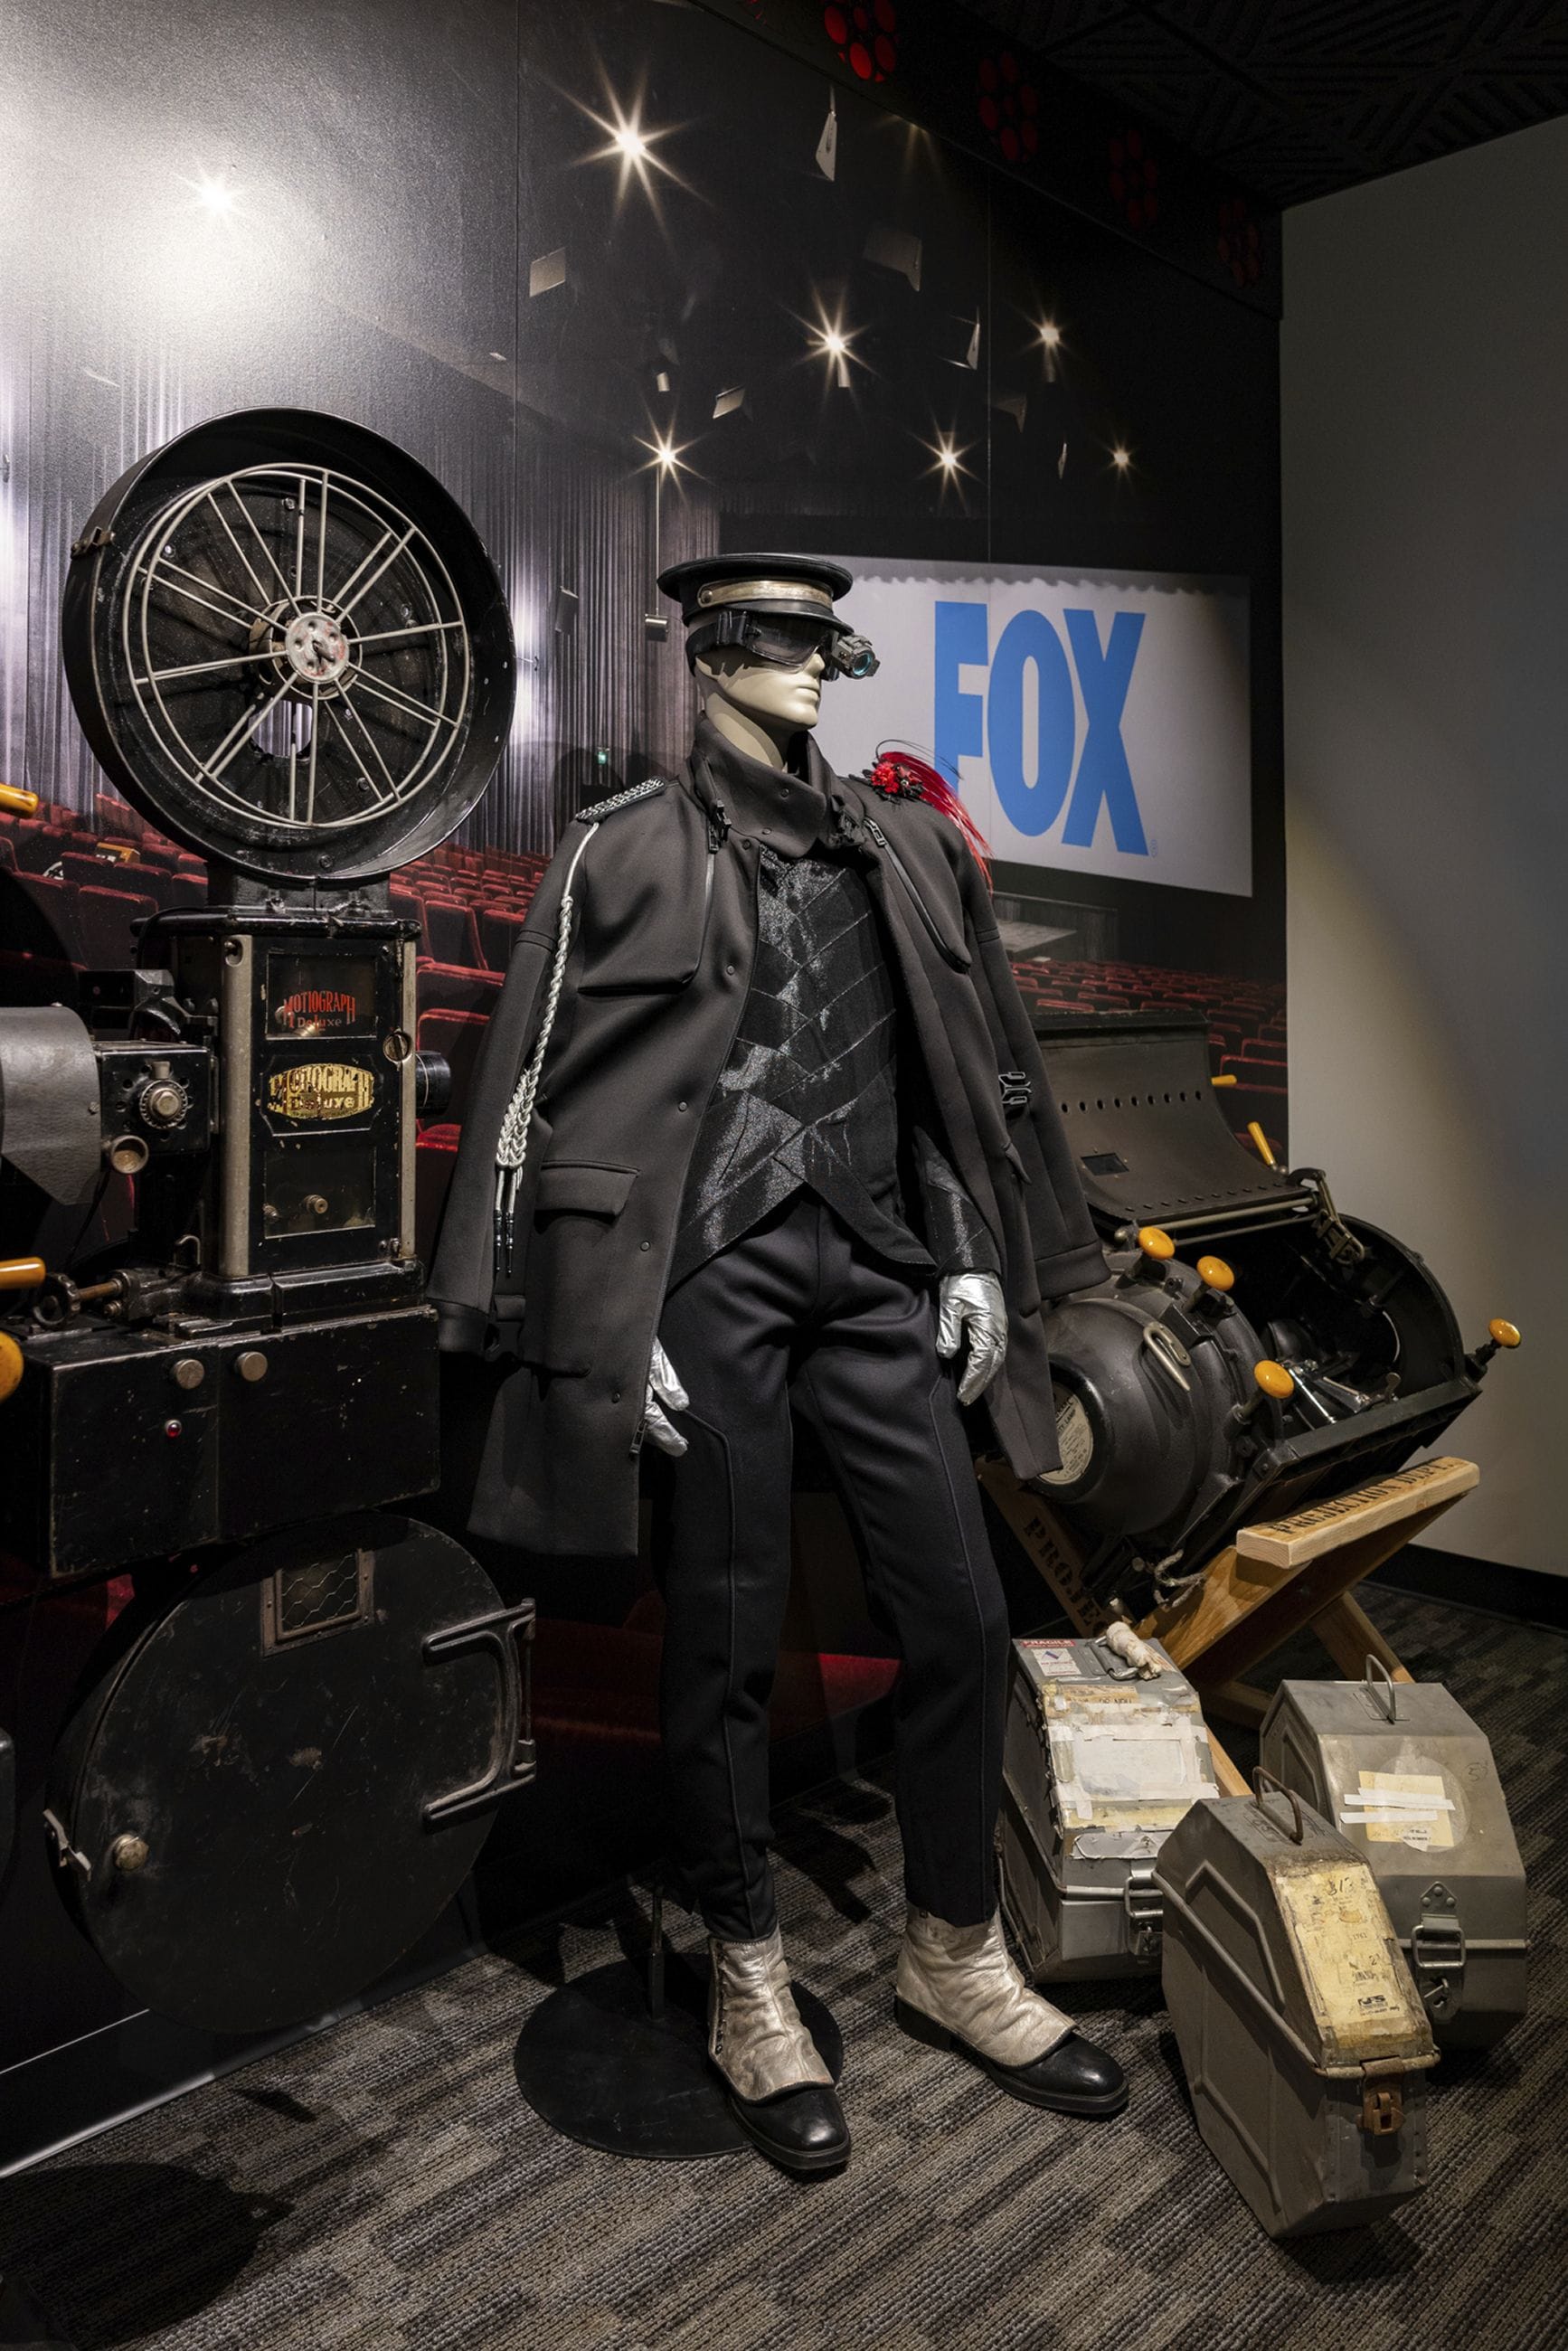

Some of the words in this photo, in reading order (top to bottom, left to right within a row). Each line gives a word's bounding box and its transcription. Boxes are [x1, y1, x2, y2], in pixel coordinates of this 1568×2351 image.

[934, 600, 1149, 856] FOX
[283, 990, 356, 1028] MOTIOGRAPH
[1269, 1478, 1402, 1534] PROJECTION
